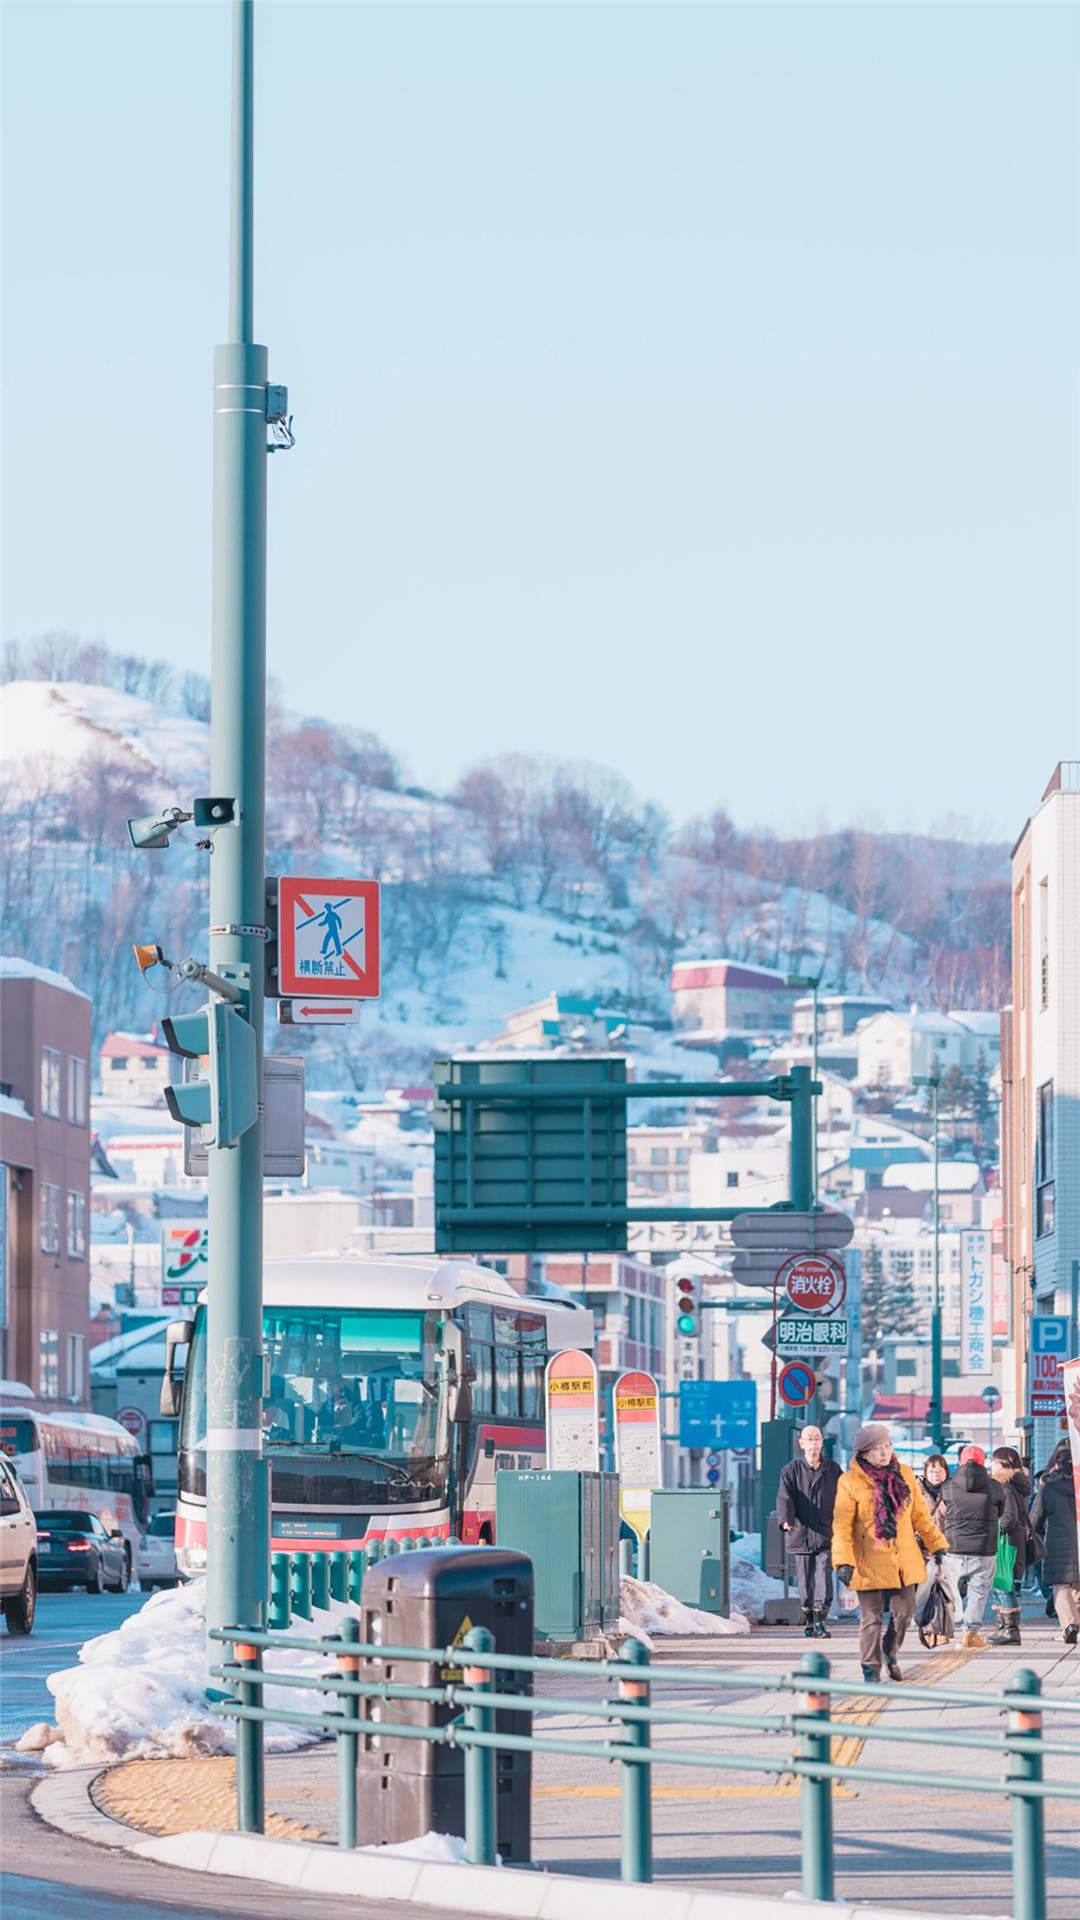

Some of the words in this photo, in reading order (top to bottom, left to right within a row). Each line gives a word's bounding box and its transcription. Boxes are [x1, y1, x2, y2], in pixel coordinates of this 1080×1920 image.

[299, 960, 346, 976] 横断禁止
[791, 1275, 832, 1295] 消火栓
[780, 1321, 847, 1343] 明治眼科
[1040, 1322, 1063, 1349] P
[550, 1381, 592, 1391] 小樽駅前
